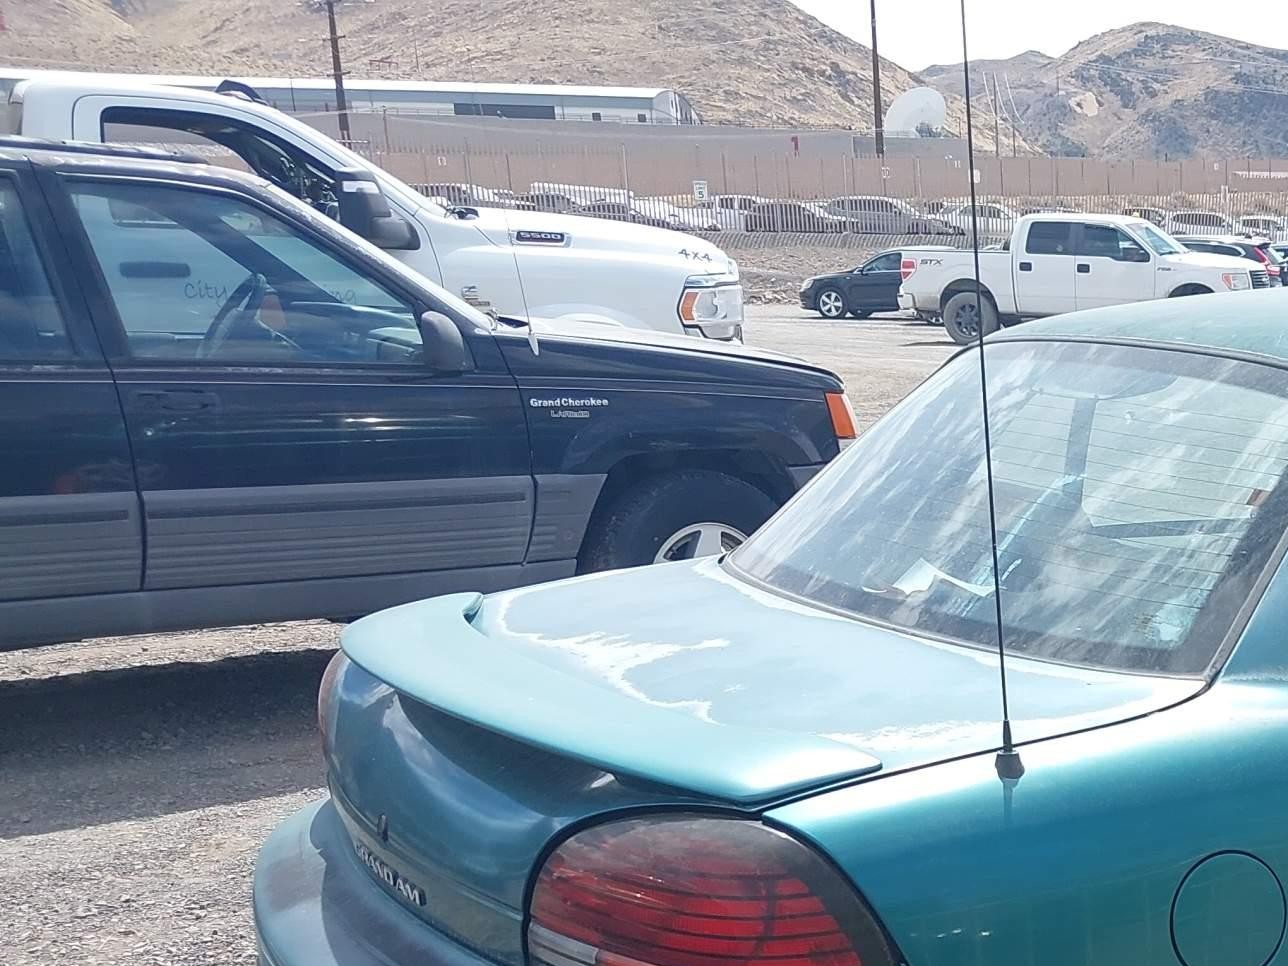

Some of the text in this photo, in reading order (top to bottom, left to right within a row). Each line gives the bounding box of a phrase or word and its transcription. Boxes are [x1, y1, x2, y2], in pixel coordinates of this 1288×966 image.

[519, 231, 562, 240] 5500
[920, 258, 944, 266] STX
[529, 397, 609, 407] Grand Cherokee
[396, 878, 420, 905] AM
